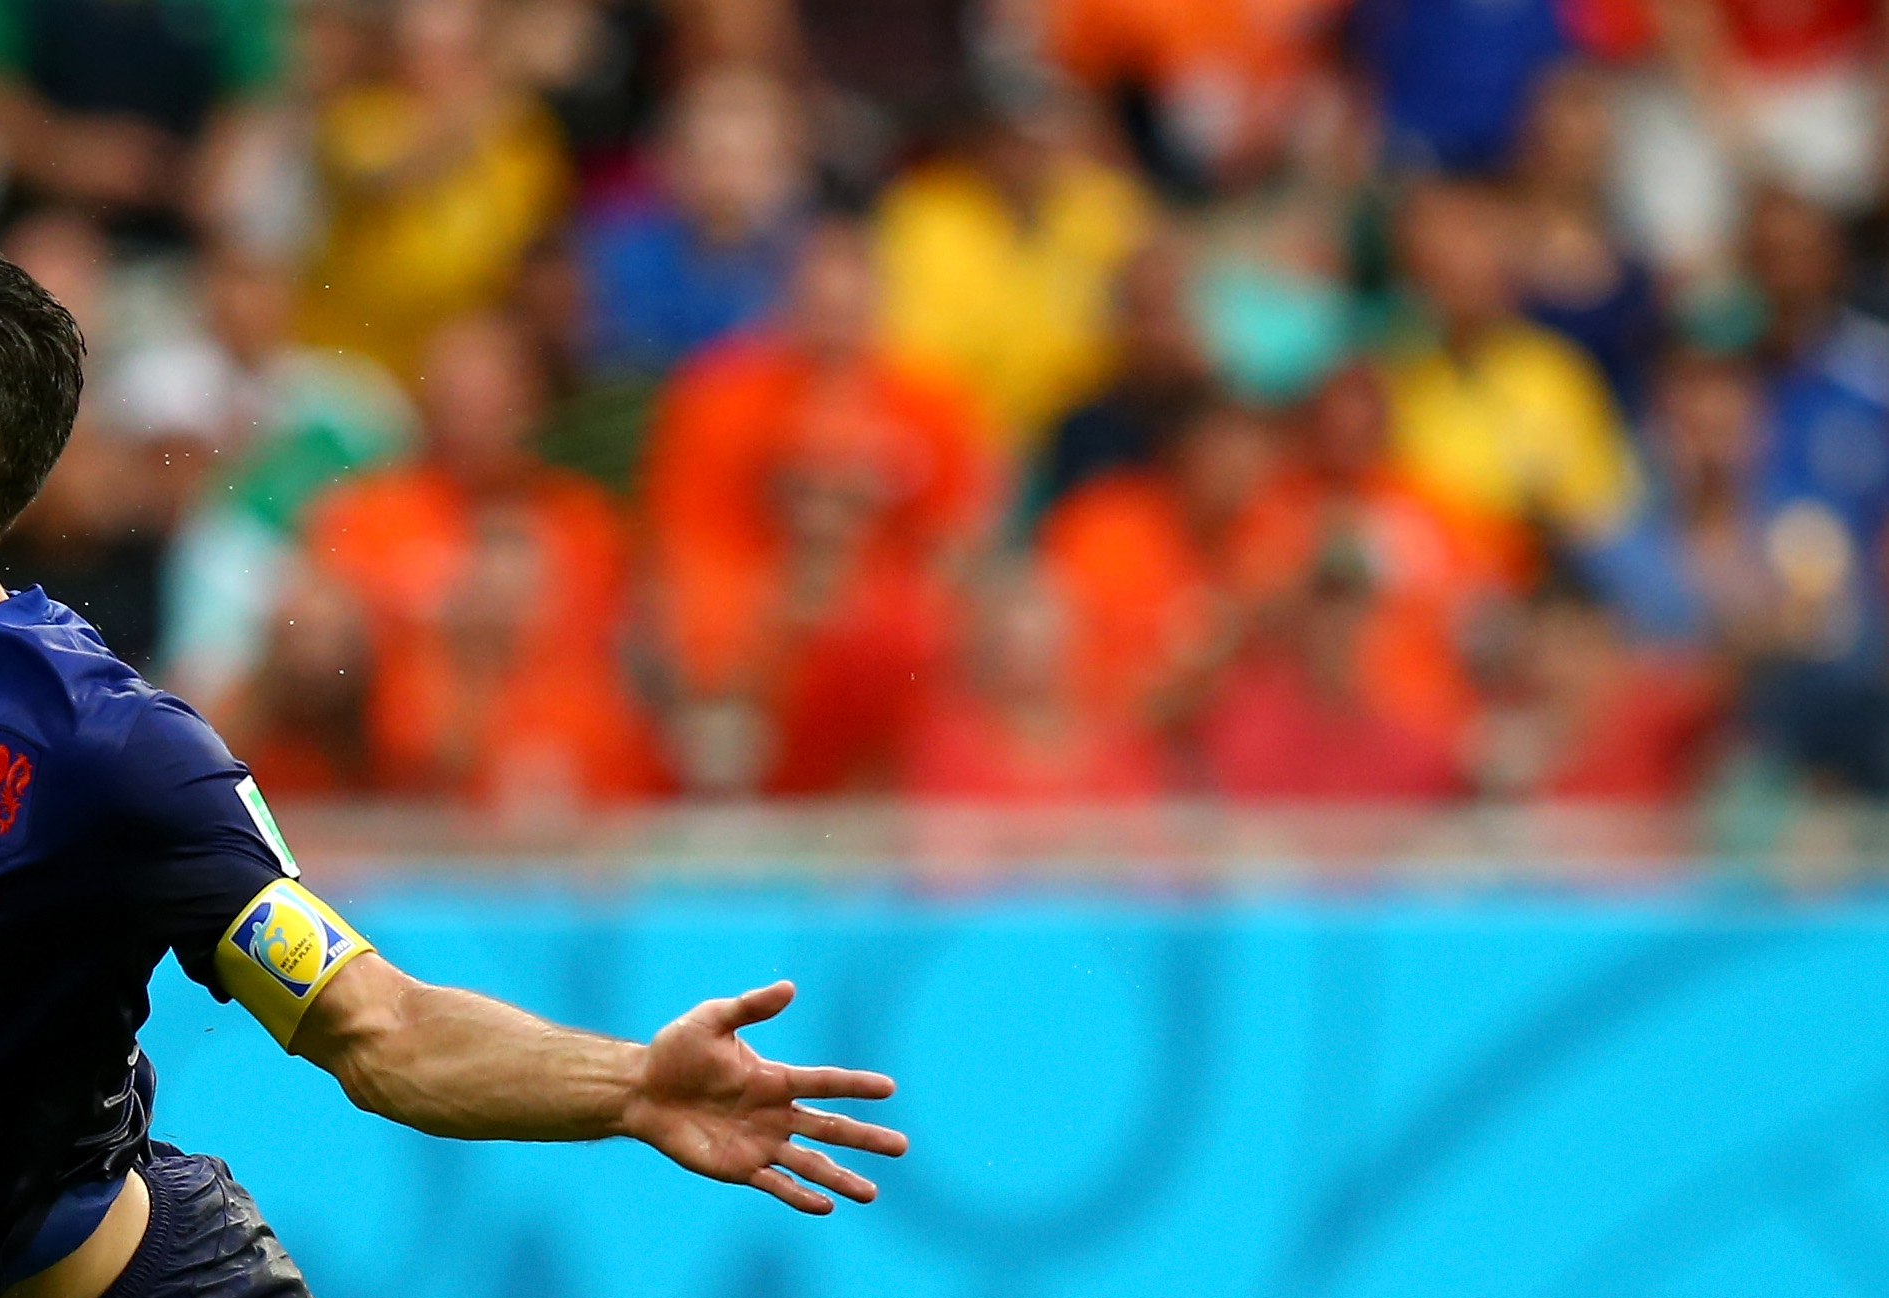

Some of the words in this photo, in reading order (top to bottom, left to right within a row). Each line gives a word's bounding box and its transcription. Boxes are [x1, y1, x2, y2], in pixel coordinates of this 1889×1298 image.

[280, 957, 290, 968] MY
[289, 938, 307, 957] GAME
[286, 959, 299, 974] FAIR
[298, 943, 313, 959] PLAY
[328, 939, 351, 958] FIFA
